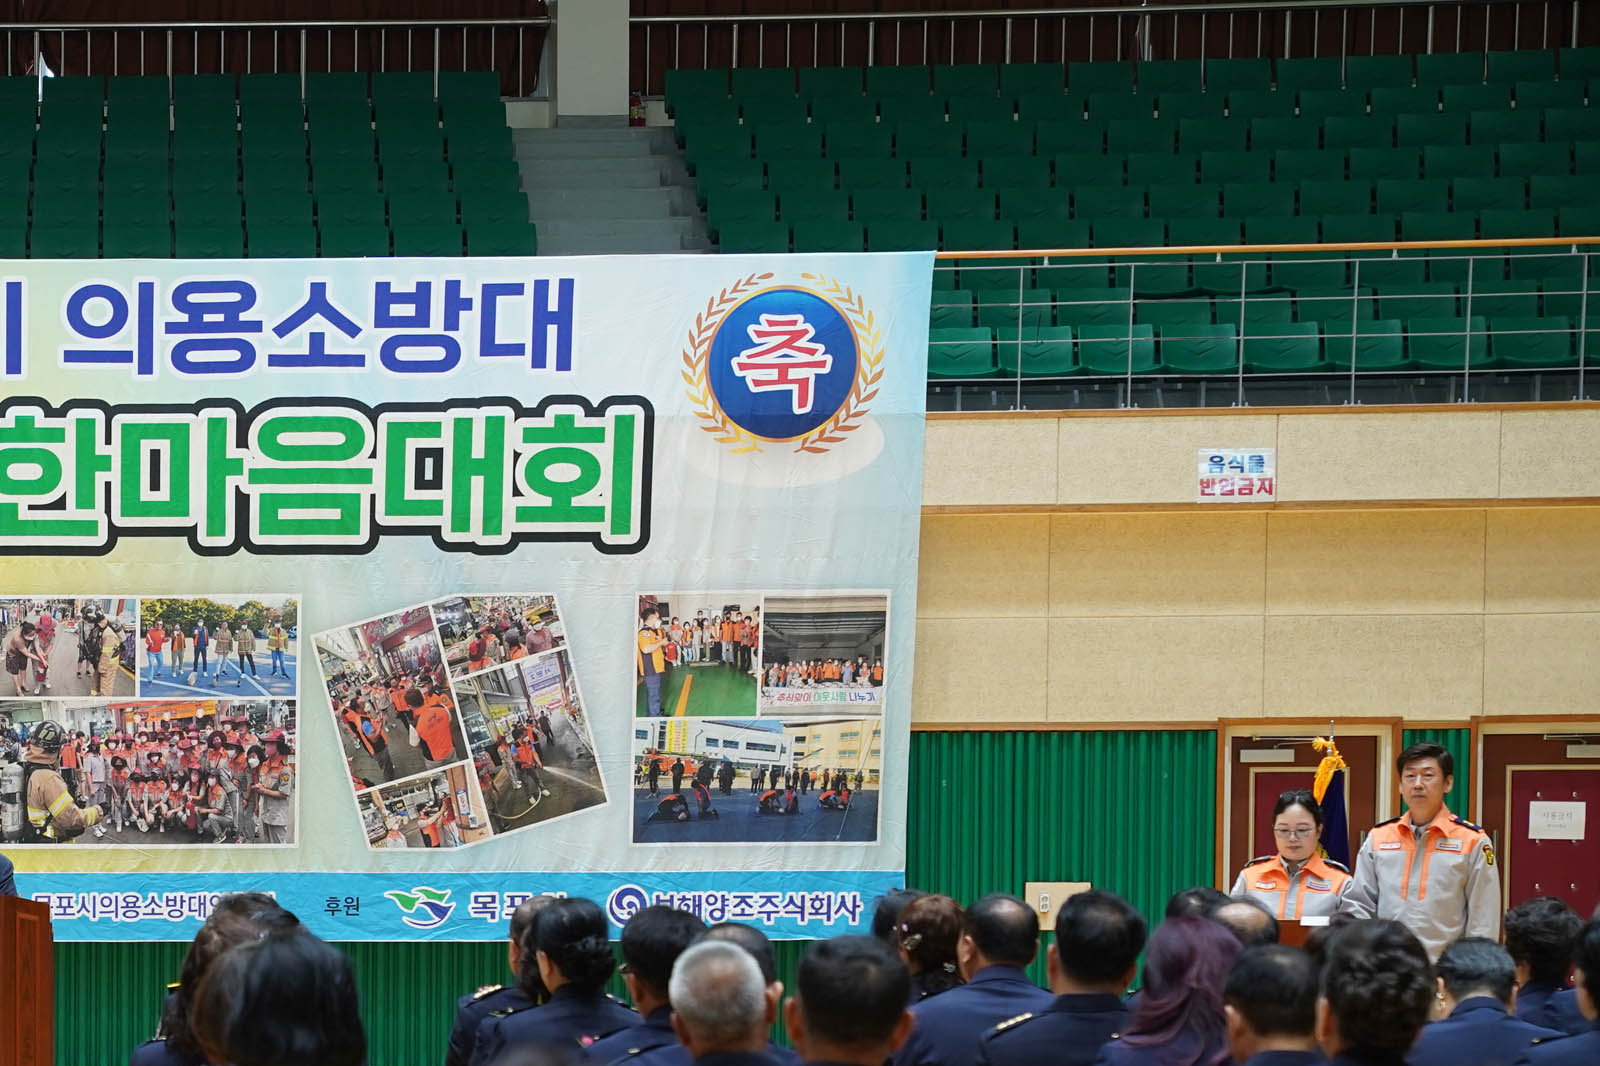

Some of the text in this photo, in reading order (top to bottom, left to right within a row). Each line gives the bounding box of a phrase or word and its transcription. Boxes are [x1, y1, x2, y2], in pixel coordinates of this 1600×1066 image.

[60, 276, 578, 376] 의용소방대
[733, 315, 831, 411] 축
[1207, 454, 1265, 474] 음식물
[1200, 477, 1274, 496] 반입금지
[324, 896, 361, 917] 후원
